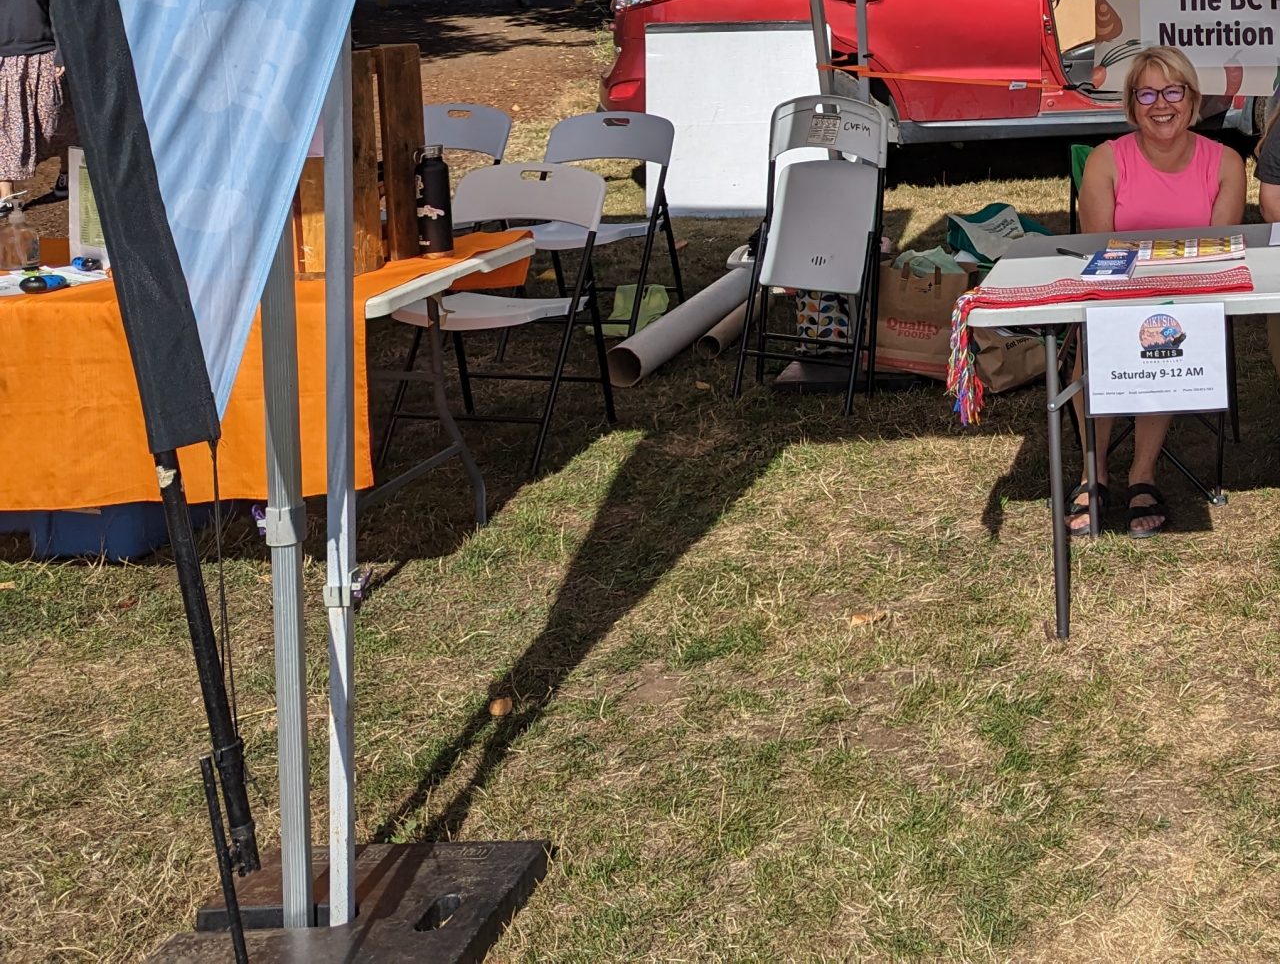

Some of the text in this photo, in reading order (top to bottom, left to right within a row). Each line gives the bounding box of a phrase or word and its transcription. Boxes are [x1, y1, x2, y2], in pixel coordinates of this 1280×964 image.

[1159, 21, 1273, 47] Nutrition
[885, 316, 942, 336] Quality
[898, 328, 933, 340] FOODS
[1005, 338, 1018, 351] Eat
[1146, 349, 1178, 358] MÉTIS
[1111, 367, 1204, 380] Saturday 9-12 AM
